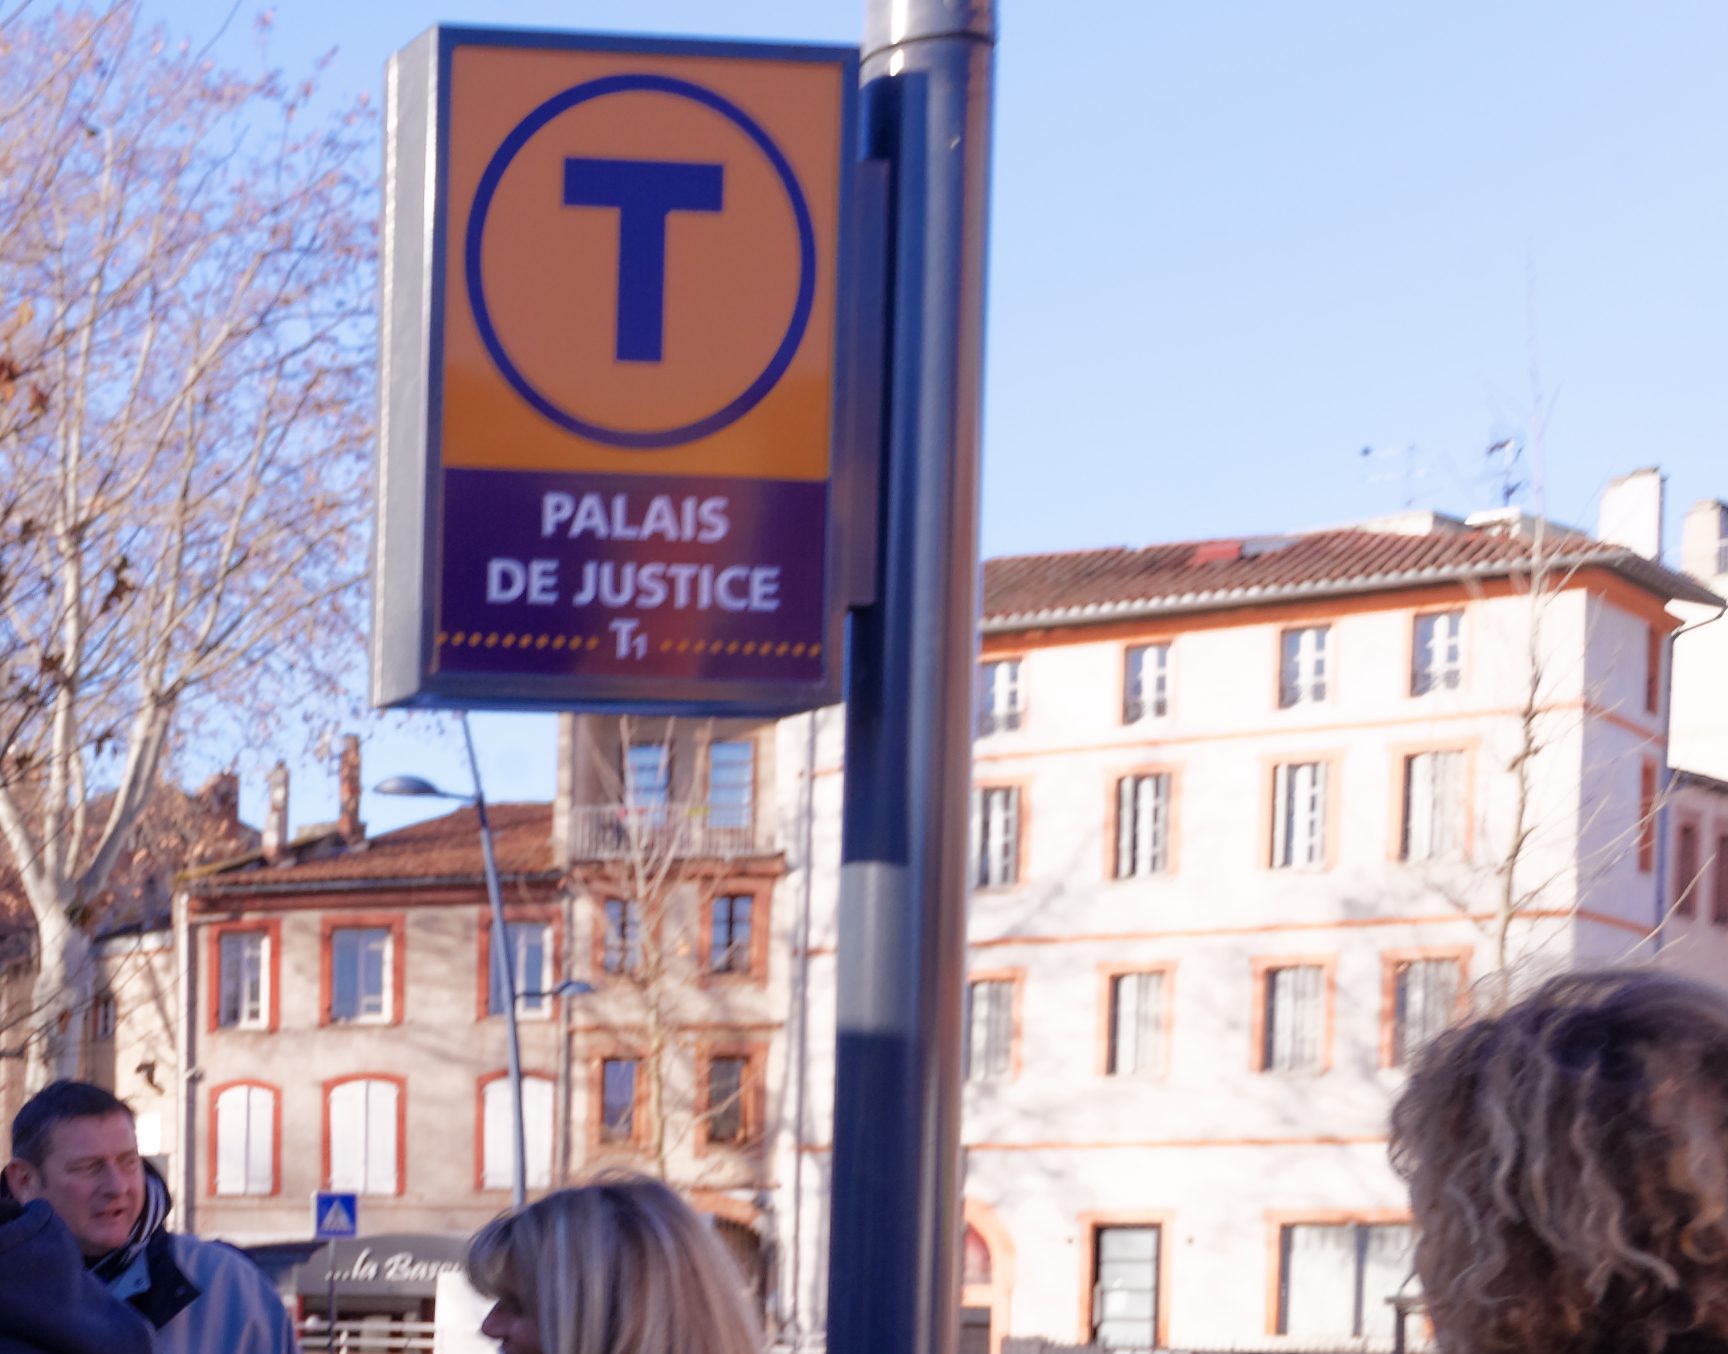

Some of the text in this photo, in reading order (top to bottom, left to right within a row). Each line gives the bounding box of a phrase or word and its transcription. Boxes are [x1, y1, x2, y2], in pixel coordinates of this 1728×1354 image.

[563, 157, 724, 363] T
[542, 492, 731, 543] PALAIS
[486, 558, 780, 612] DE JUSTICE
[609, 617, 648, 660] T1
